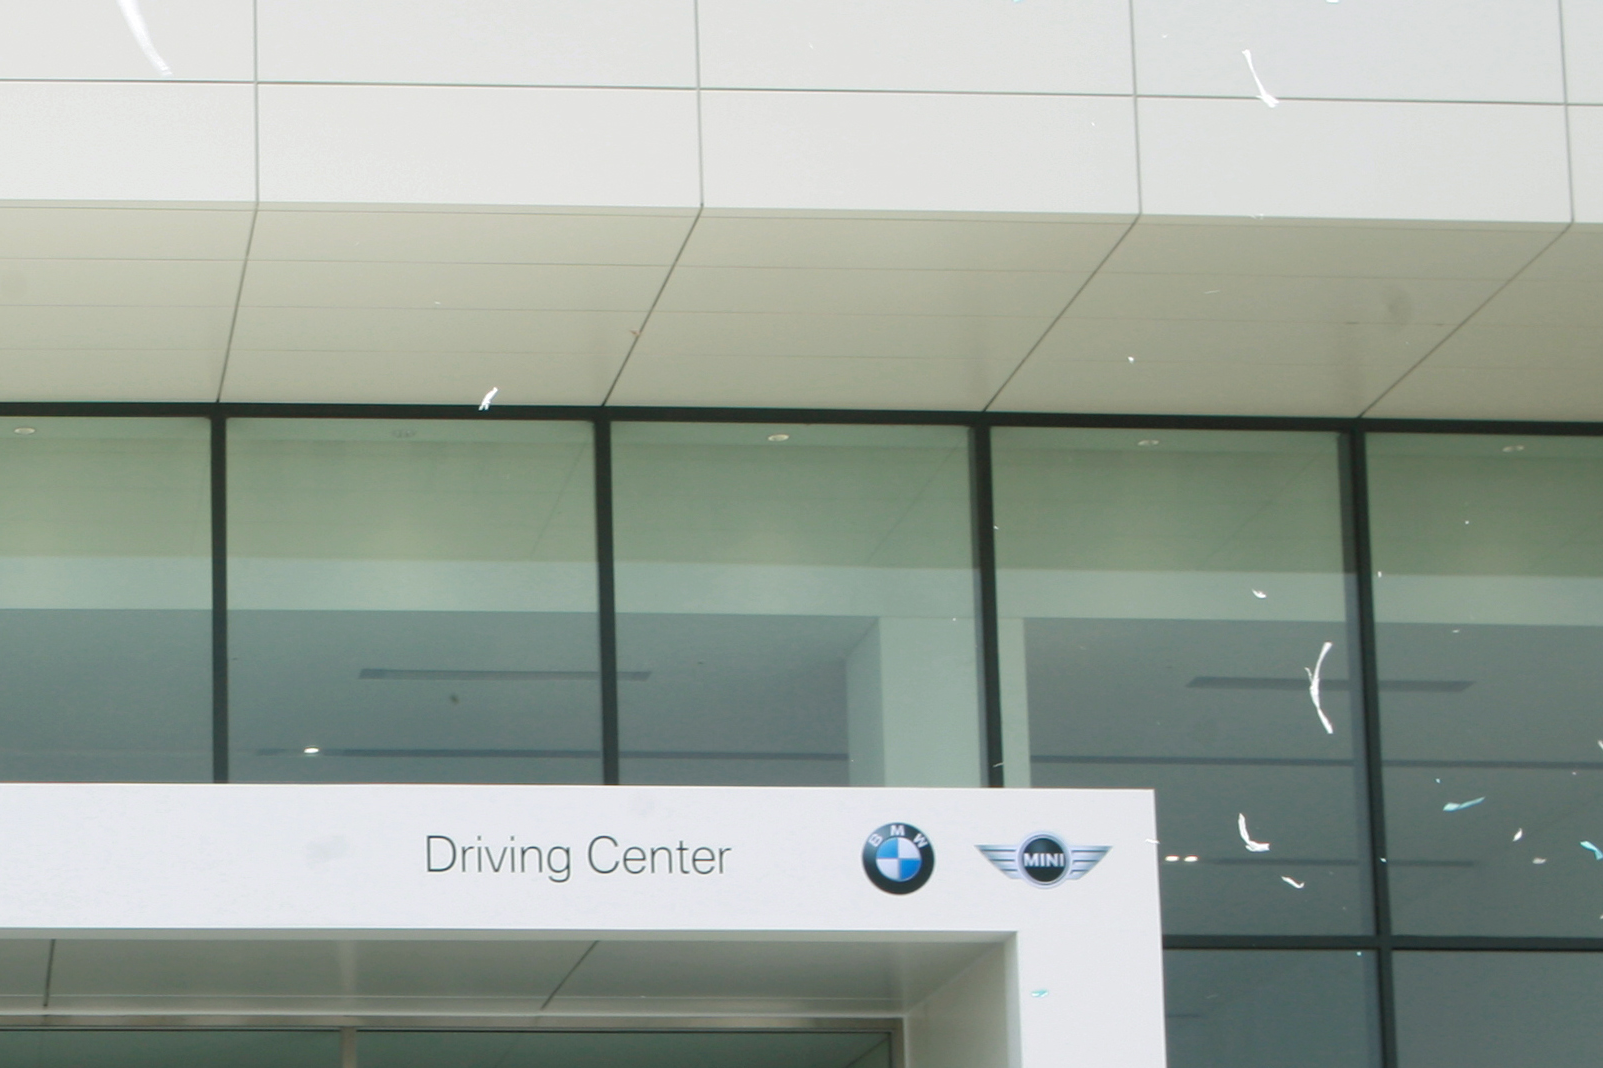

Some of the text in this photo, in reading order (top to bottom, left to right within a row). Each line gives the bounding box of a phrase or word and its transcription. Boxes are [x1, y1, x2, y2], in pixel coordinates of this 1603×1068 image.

[868, 825, 928, 848] BMW
[426, 835, 732, 883] Driving Center
[1023, 852, 1065, 868] MINI
